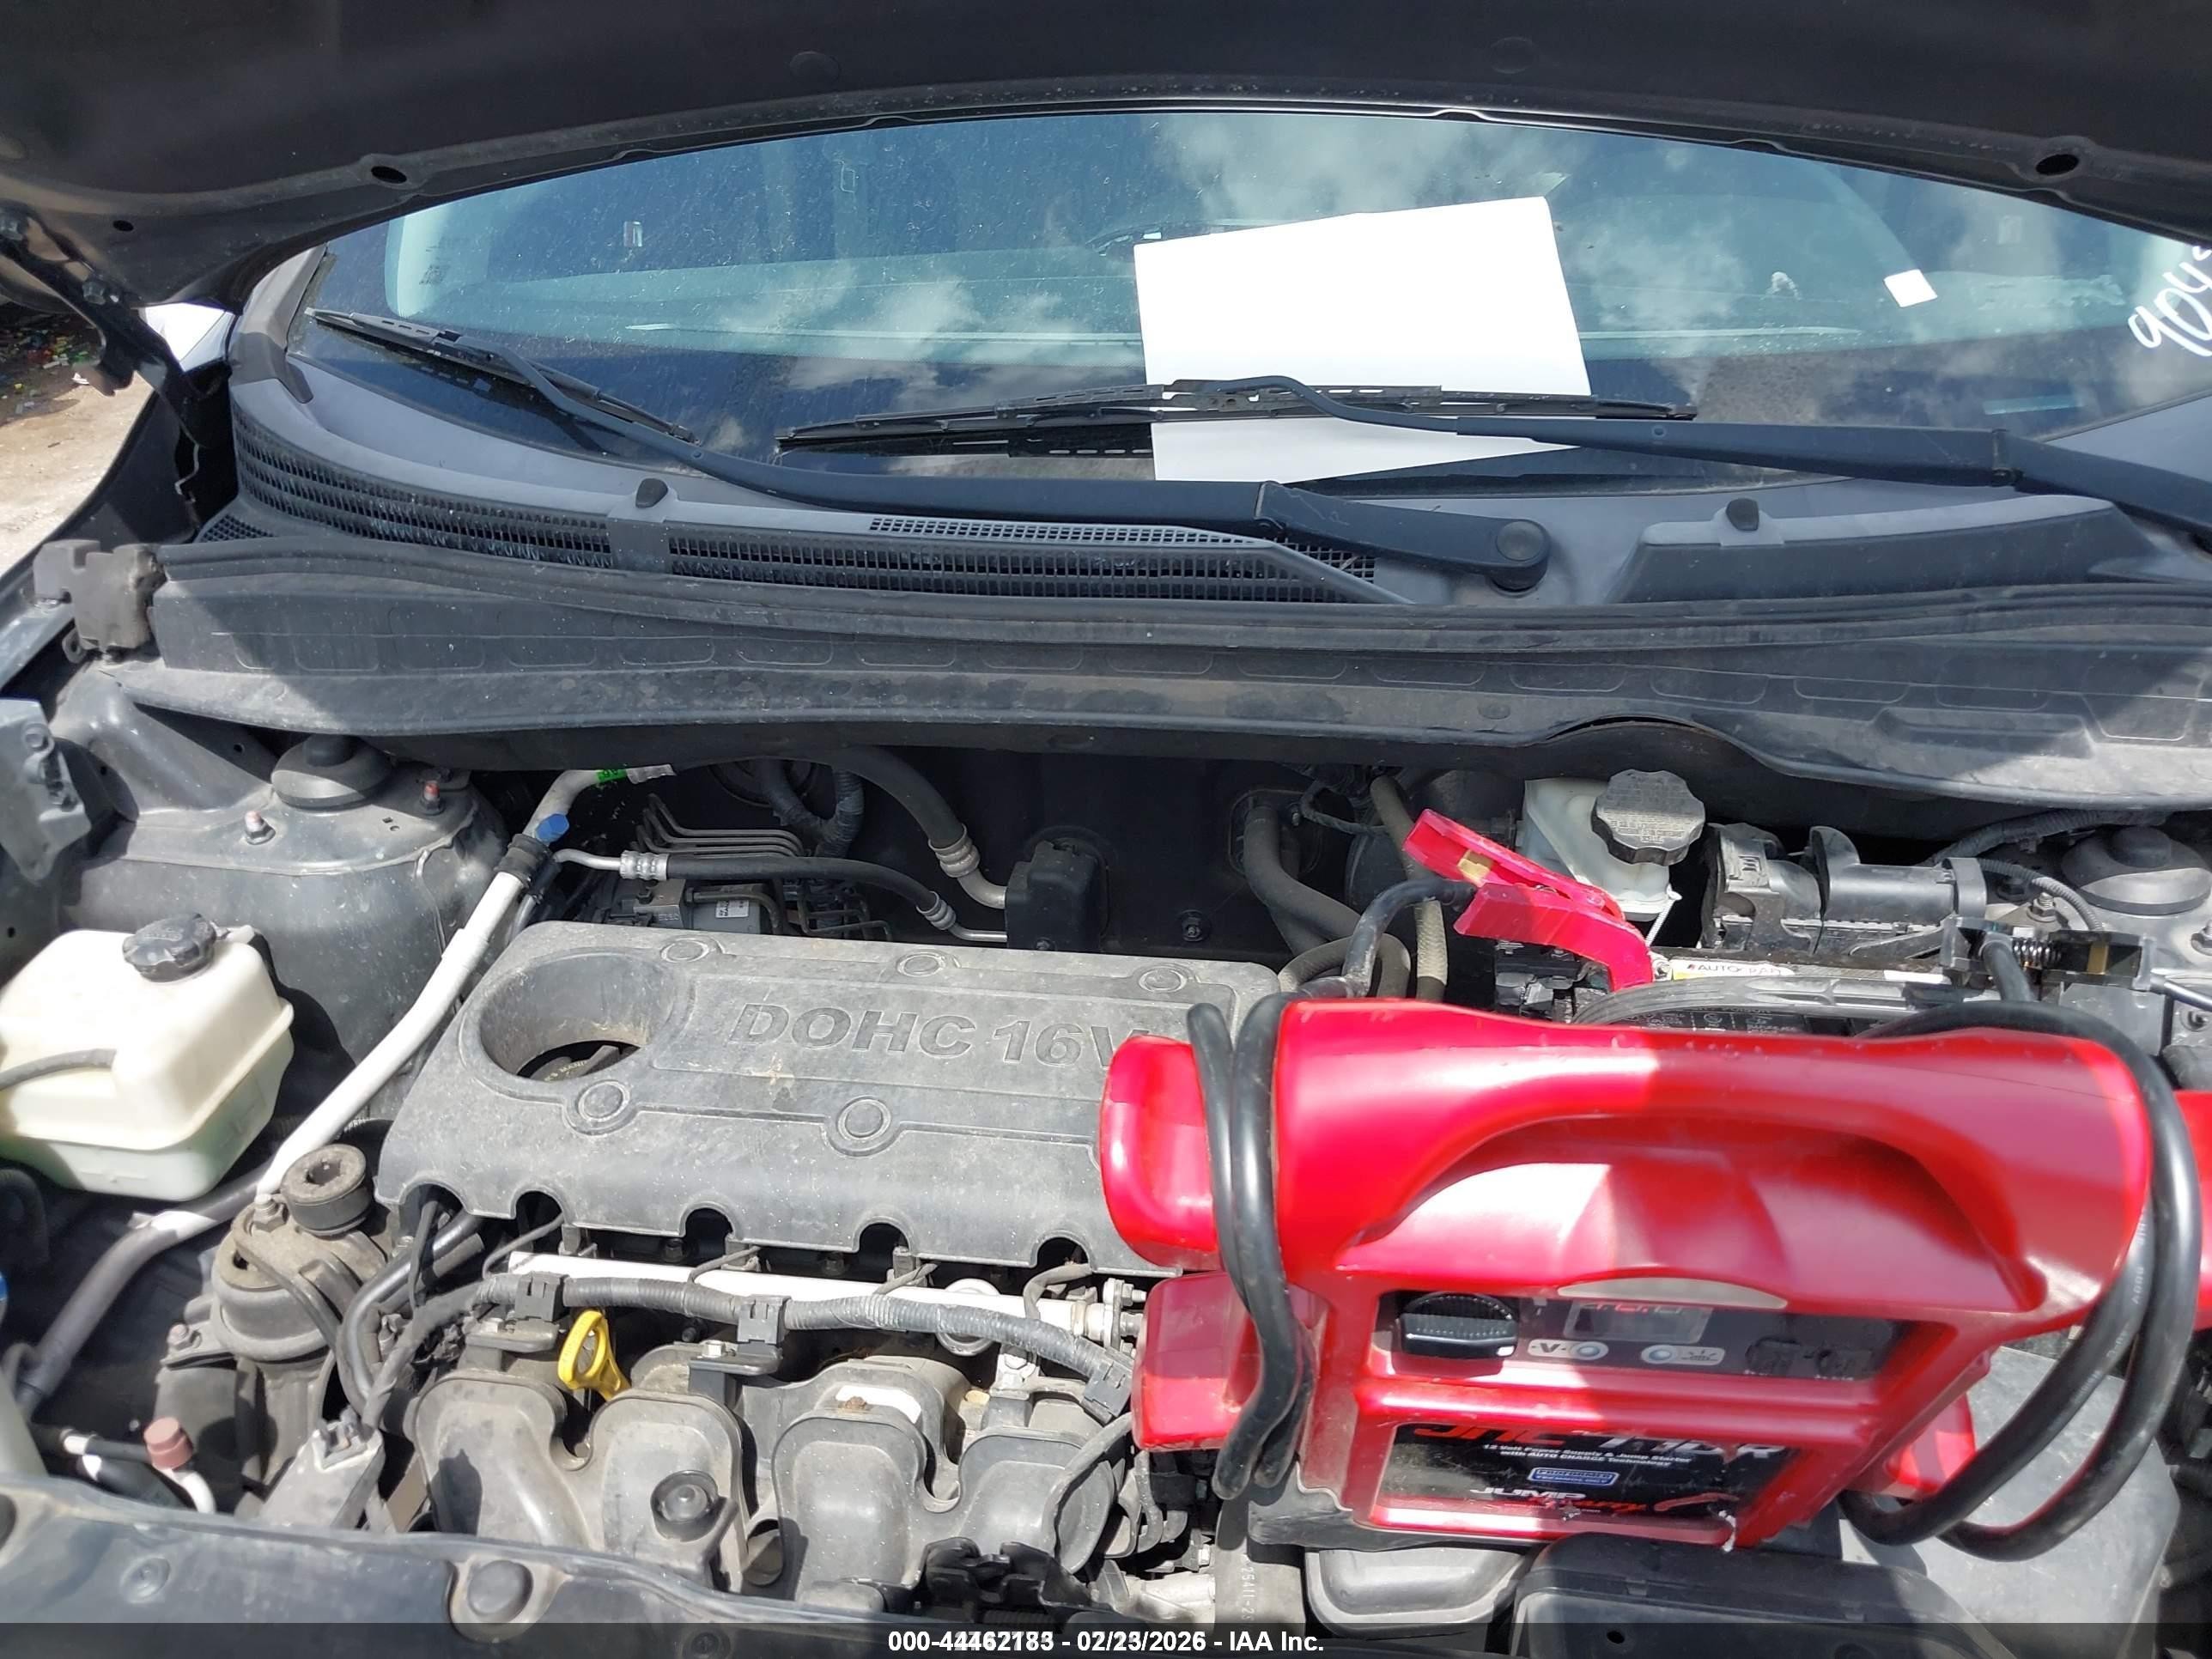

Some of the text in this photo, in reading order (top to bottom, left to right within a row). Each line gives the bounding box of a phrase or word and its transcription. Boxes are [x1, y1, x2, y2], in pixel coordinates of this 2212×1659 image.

[729, 1002, 1151, 1070] DOHC 16V
[1469, 1487, 1586, 1499] JUMP
